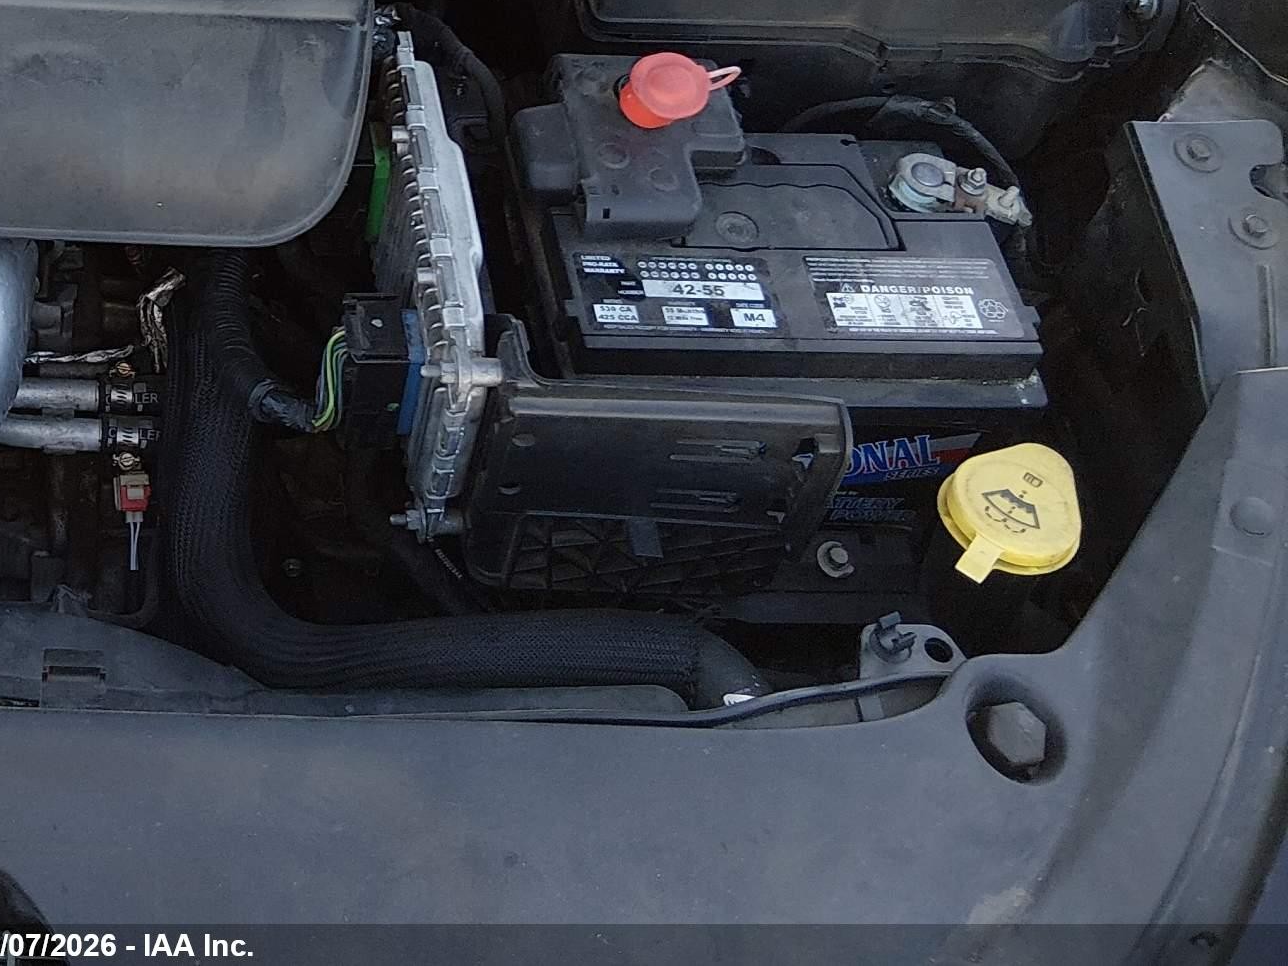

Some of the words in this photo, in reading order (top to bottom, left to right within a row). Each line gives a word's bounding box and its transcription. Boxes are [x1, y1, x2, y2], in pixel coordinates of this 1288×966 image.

[672, 285, 726, 297] 42-55
[860, 284, 975, 295] DANGER/POISON
[617, 314, 639, 322] CCA
[743, 312, 766, 322] M4
[105, 392, 159, 405] CLER
